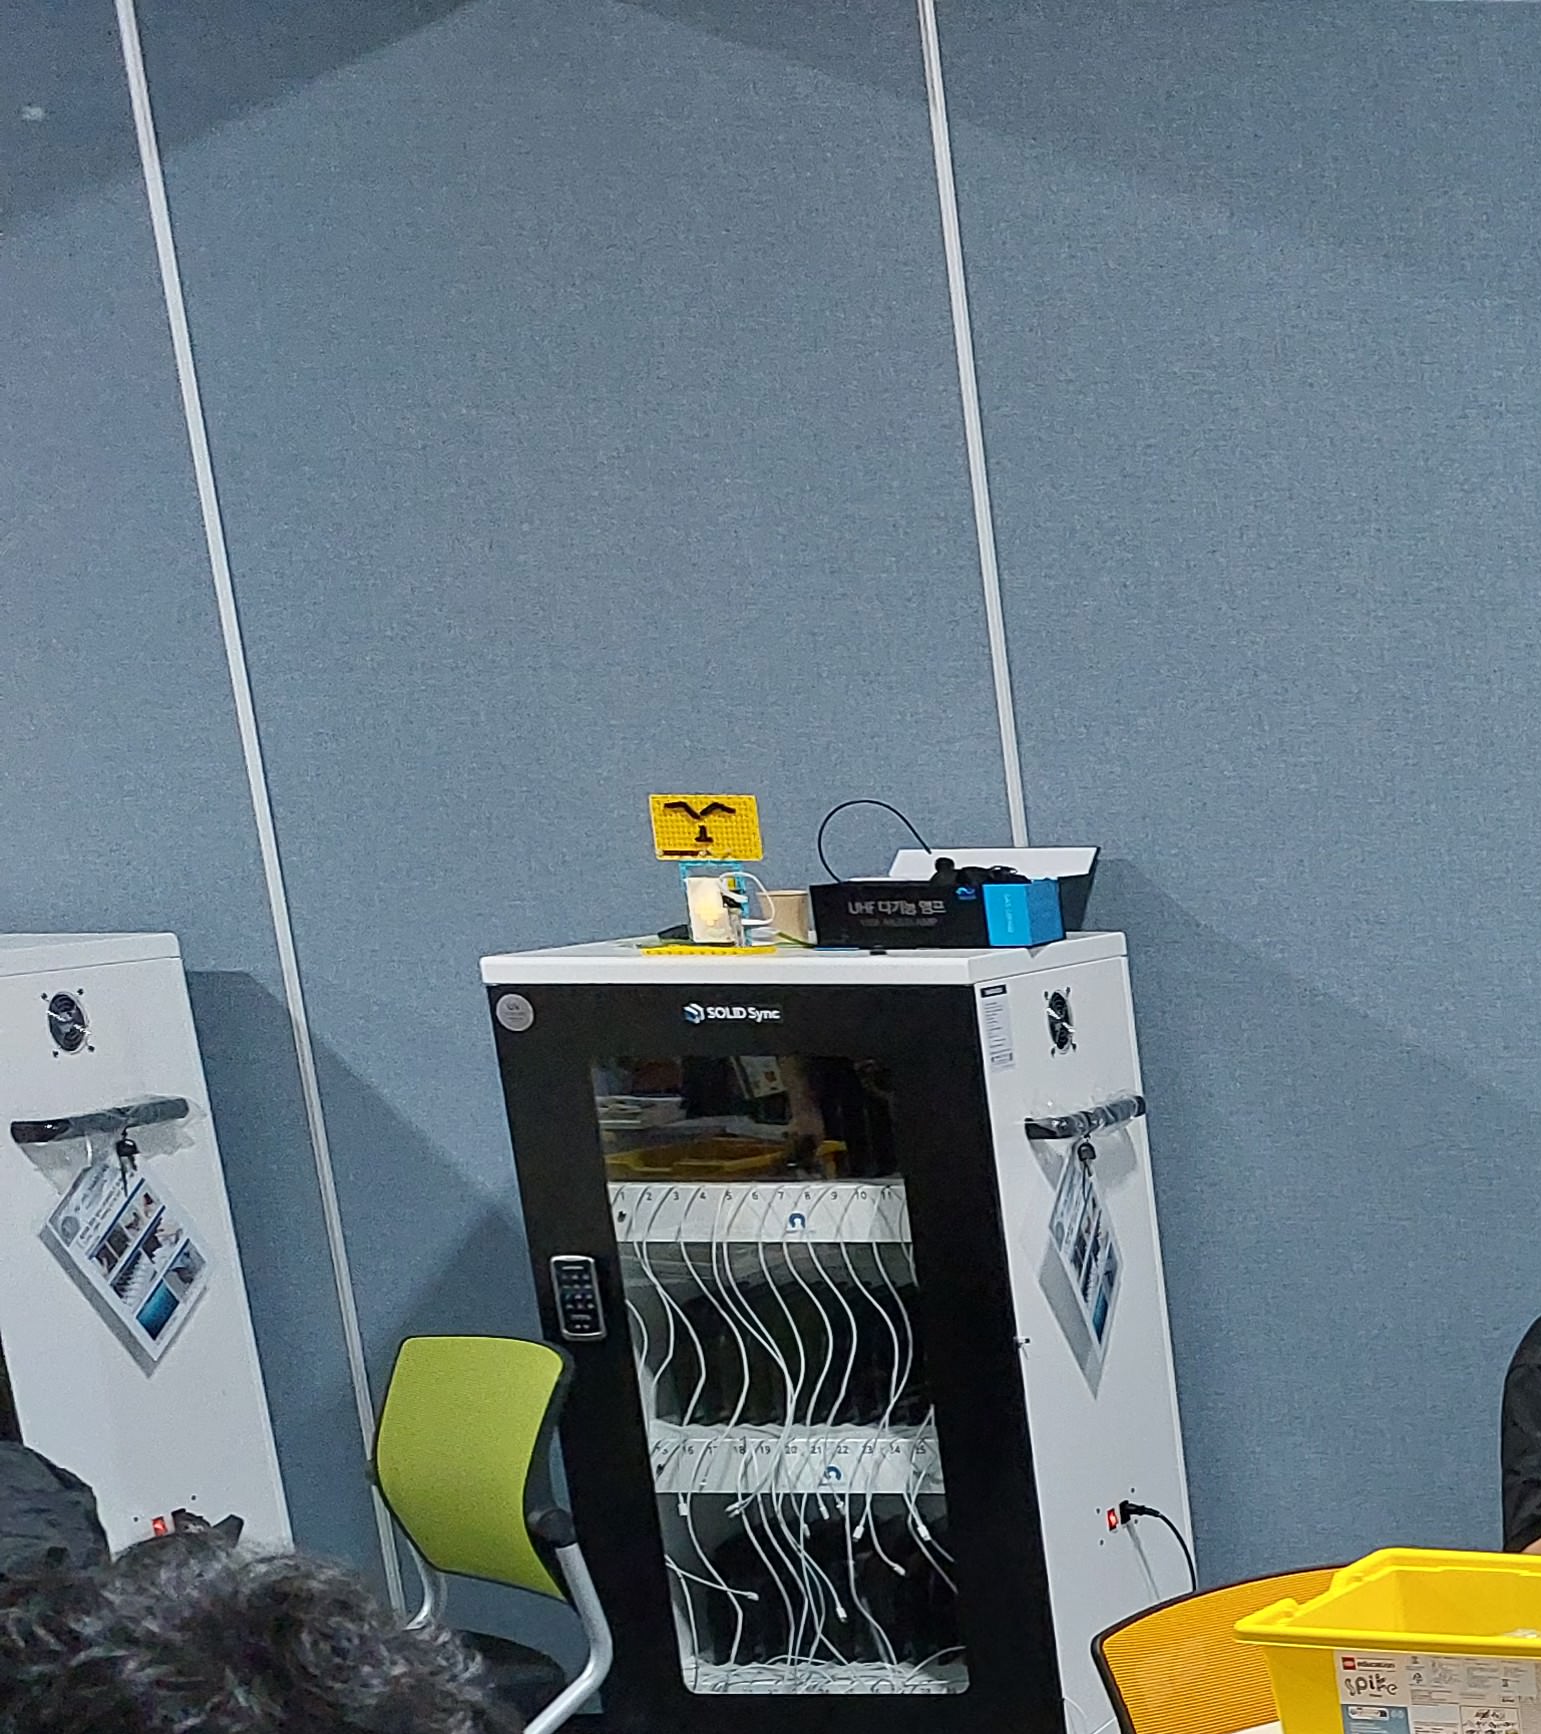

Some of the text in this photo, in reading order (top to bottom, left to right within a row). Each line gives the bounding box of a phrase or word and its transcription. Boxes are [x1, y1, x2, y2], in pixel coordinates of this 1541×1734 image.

[848, 901, 874, 915] UHF
[877, 900, 916, 915] 다기능
[706, 1006, 780, 1023] SOLID Sync
